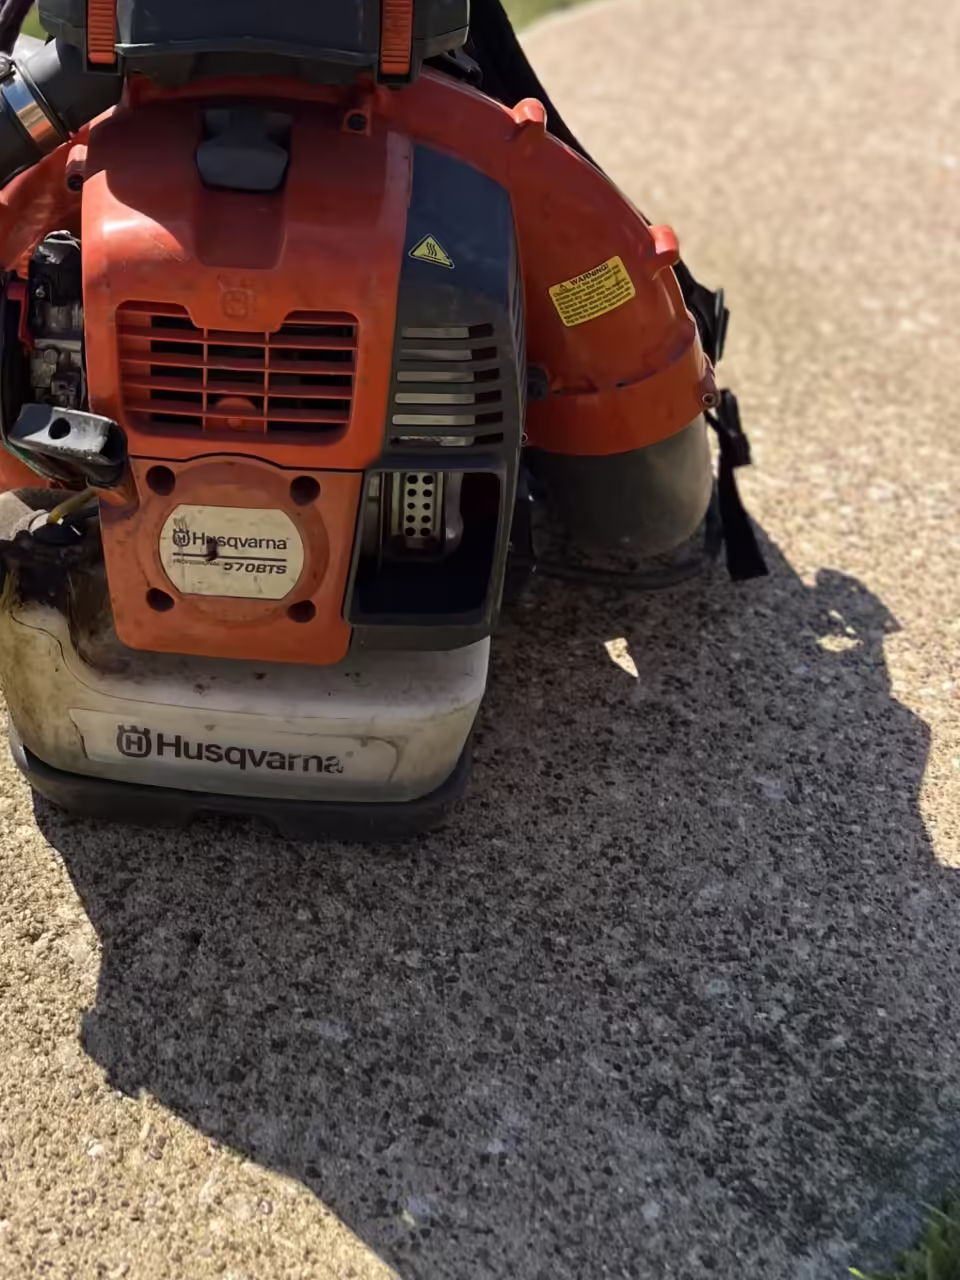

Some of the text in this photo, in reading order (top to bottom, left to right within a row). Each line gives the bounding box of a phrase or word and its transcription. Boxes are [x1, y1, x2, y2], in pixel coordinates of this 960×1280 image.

[569, 263, 609, 286] WARNING!
[223, 561, 288, 575] 570BTS
[156, 732, 344, 774] Husqvarna
